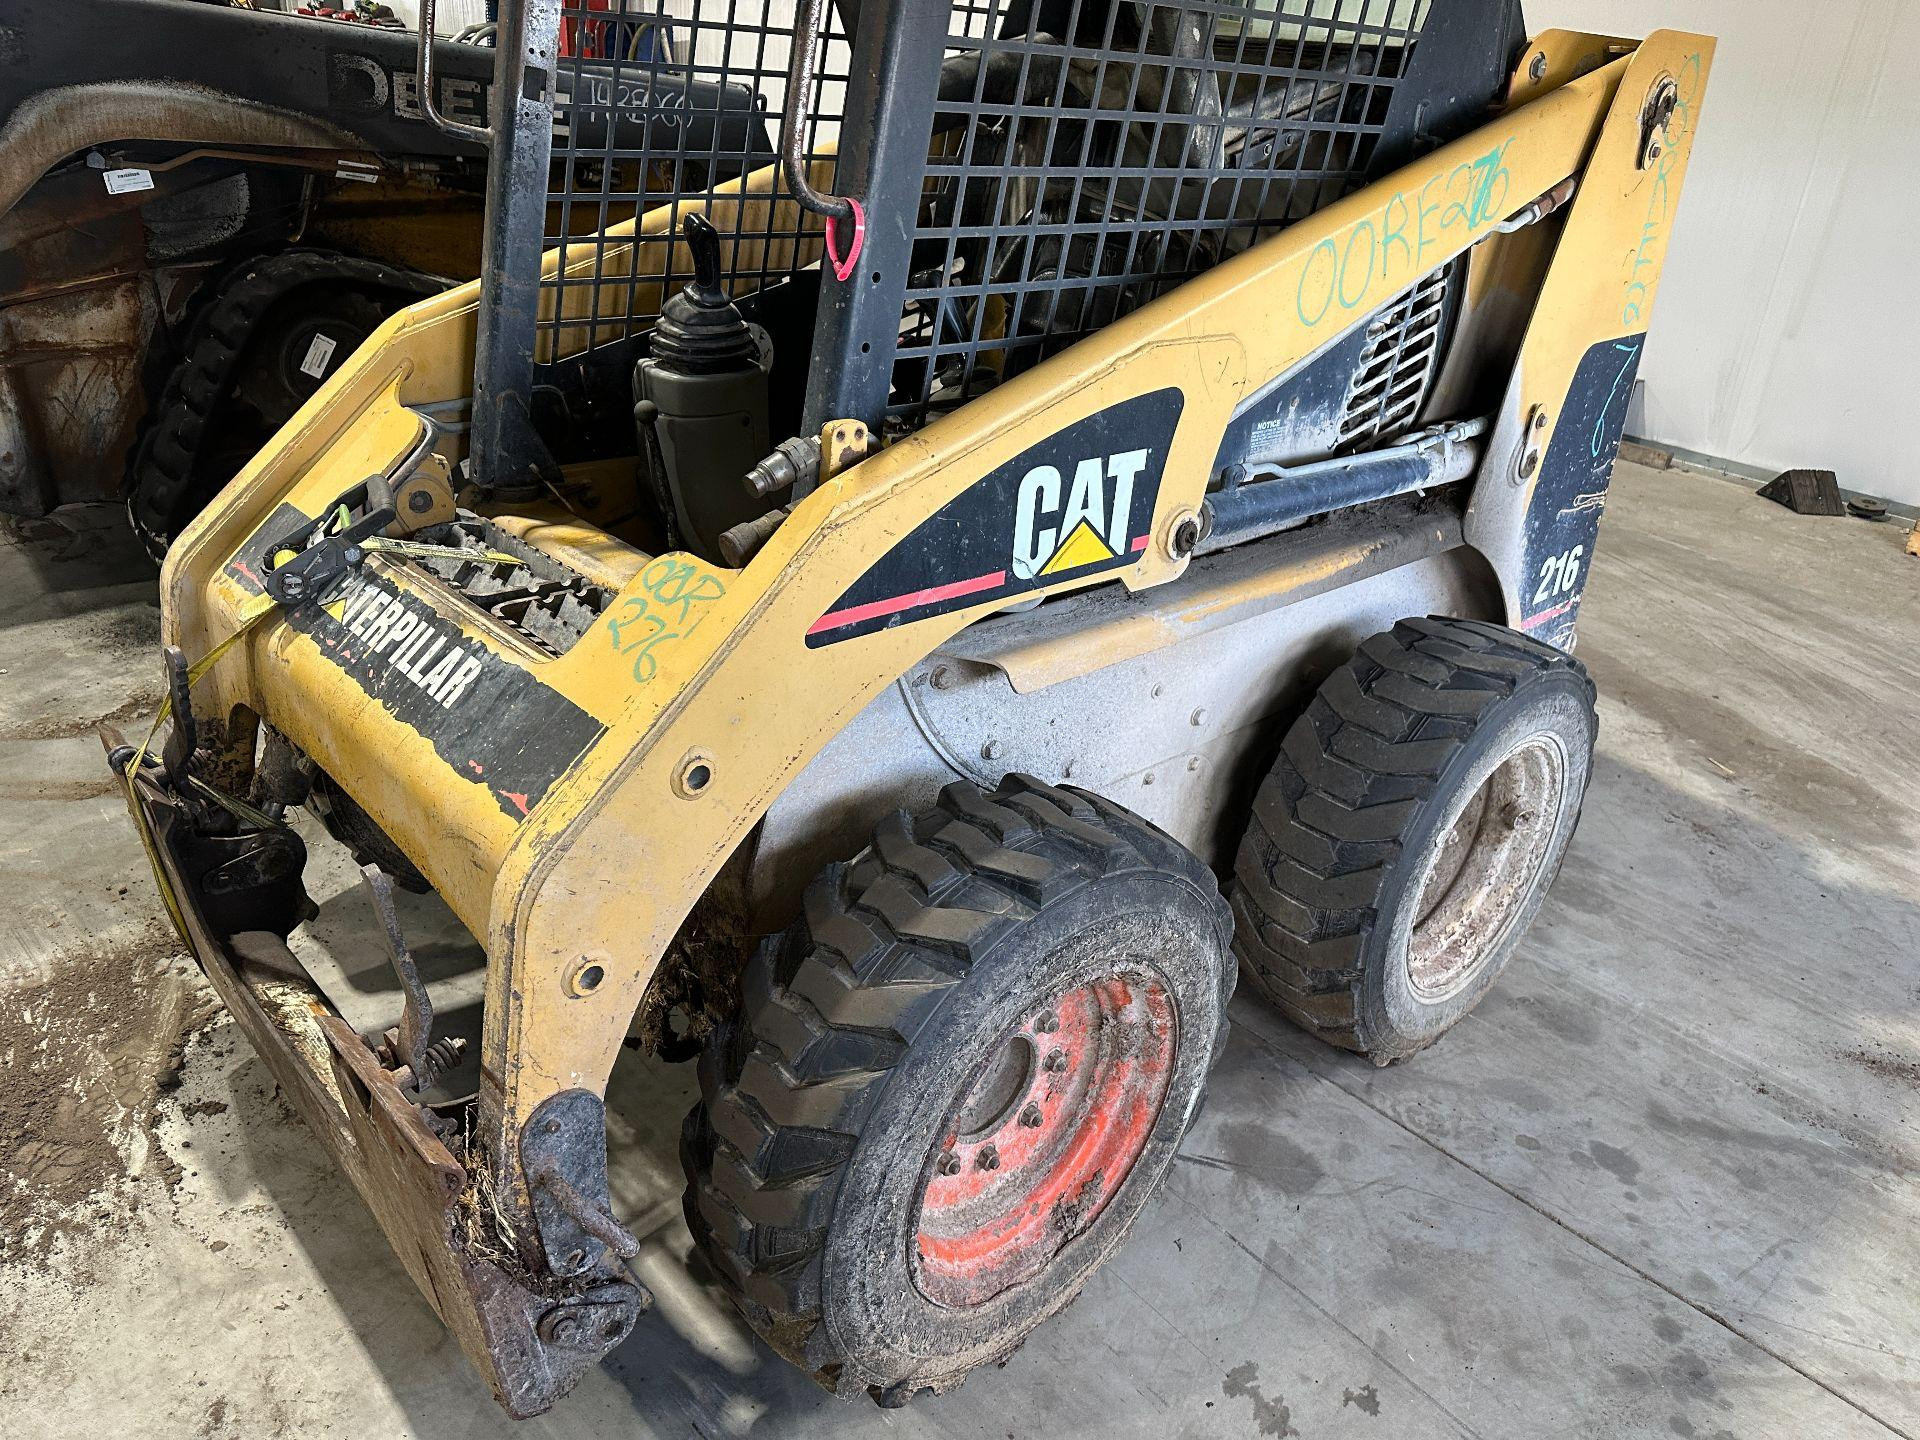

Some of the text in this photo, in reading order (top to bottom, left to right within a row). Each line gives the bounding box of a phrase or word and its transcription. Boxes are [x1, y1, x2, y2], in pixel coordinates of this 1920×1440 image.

[334, 53, 571, 136] DEEE
[1257, 419, 1281, 431] NOTICE
[1012, 448, 1149, 580] CAT
[1532, 544, 1584, 606] 216
